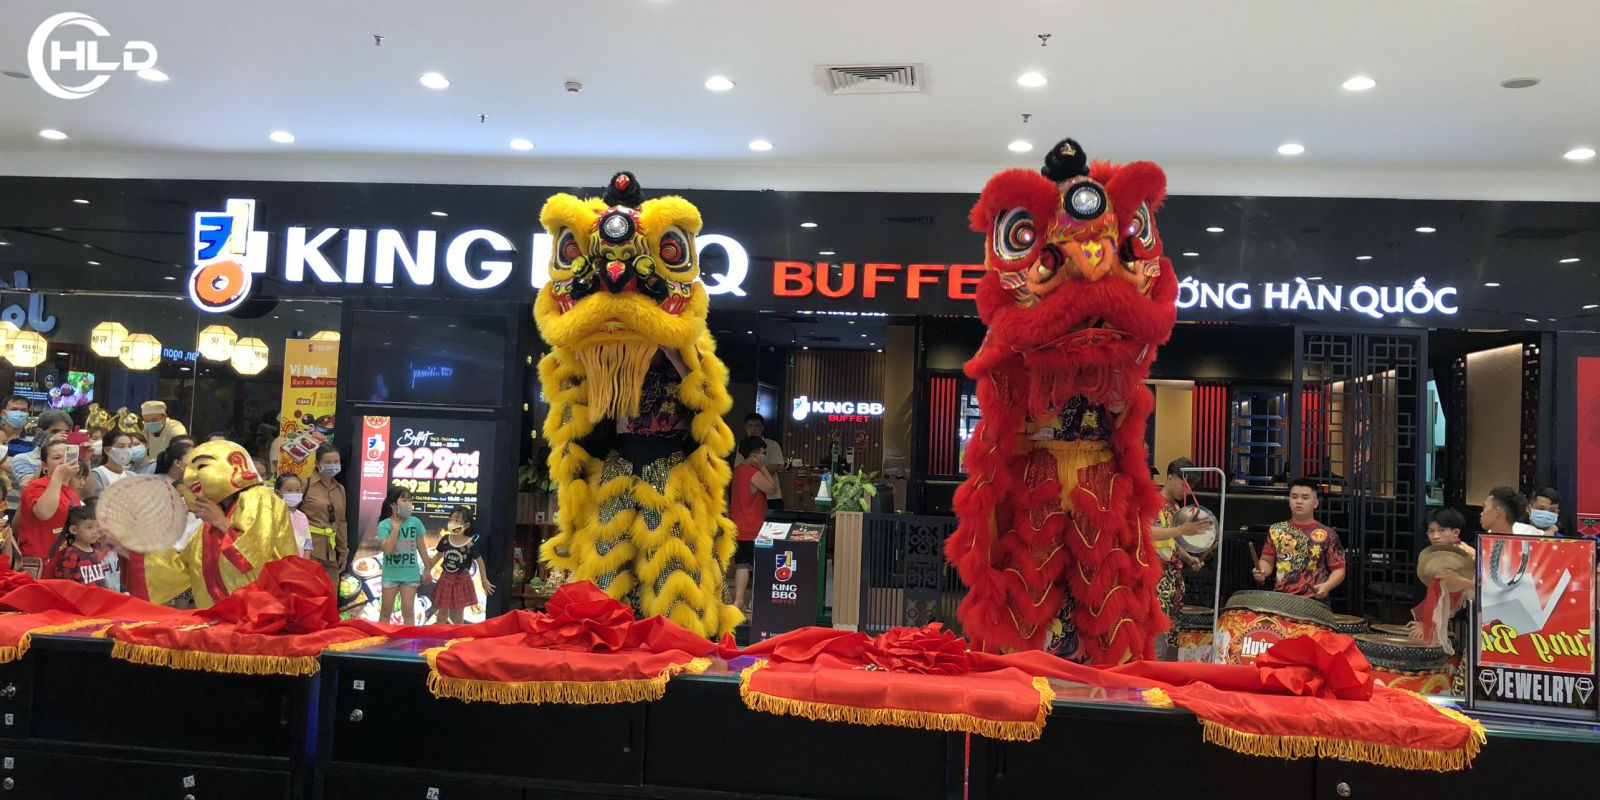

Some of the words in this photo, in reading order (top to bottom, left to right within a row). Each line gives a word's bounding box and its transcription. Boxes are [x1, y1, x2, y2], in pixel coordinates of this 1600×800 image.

[285, 226, 513, 289] KING
[773, 261, 985, 299] BUFFE
[1175, 275, 1252, 309] ỚNG
[1264, 277, 1343, 312] HÀN
[1349, 276, 1459, 318] QUỐC
[812, 401, 855, 414] KING
[857, 403, 885, 415] BB
[828, 414, 870, 423] BUFFET
[393, 447, 454, 479] 229
[438, 480, 465, 494] 349
[771, 591, 797, 600] BBQ
[772, 583, 798, 592] KING
[1496, 667, 1576, 704] JEWELRY
